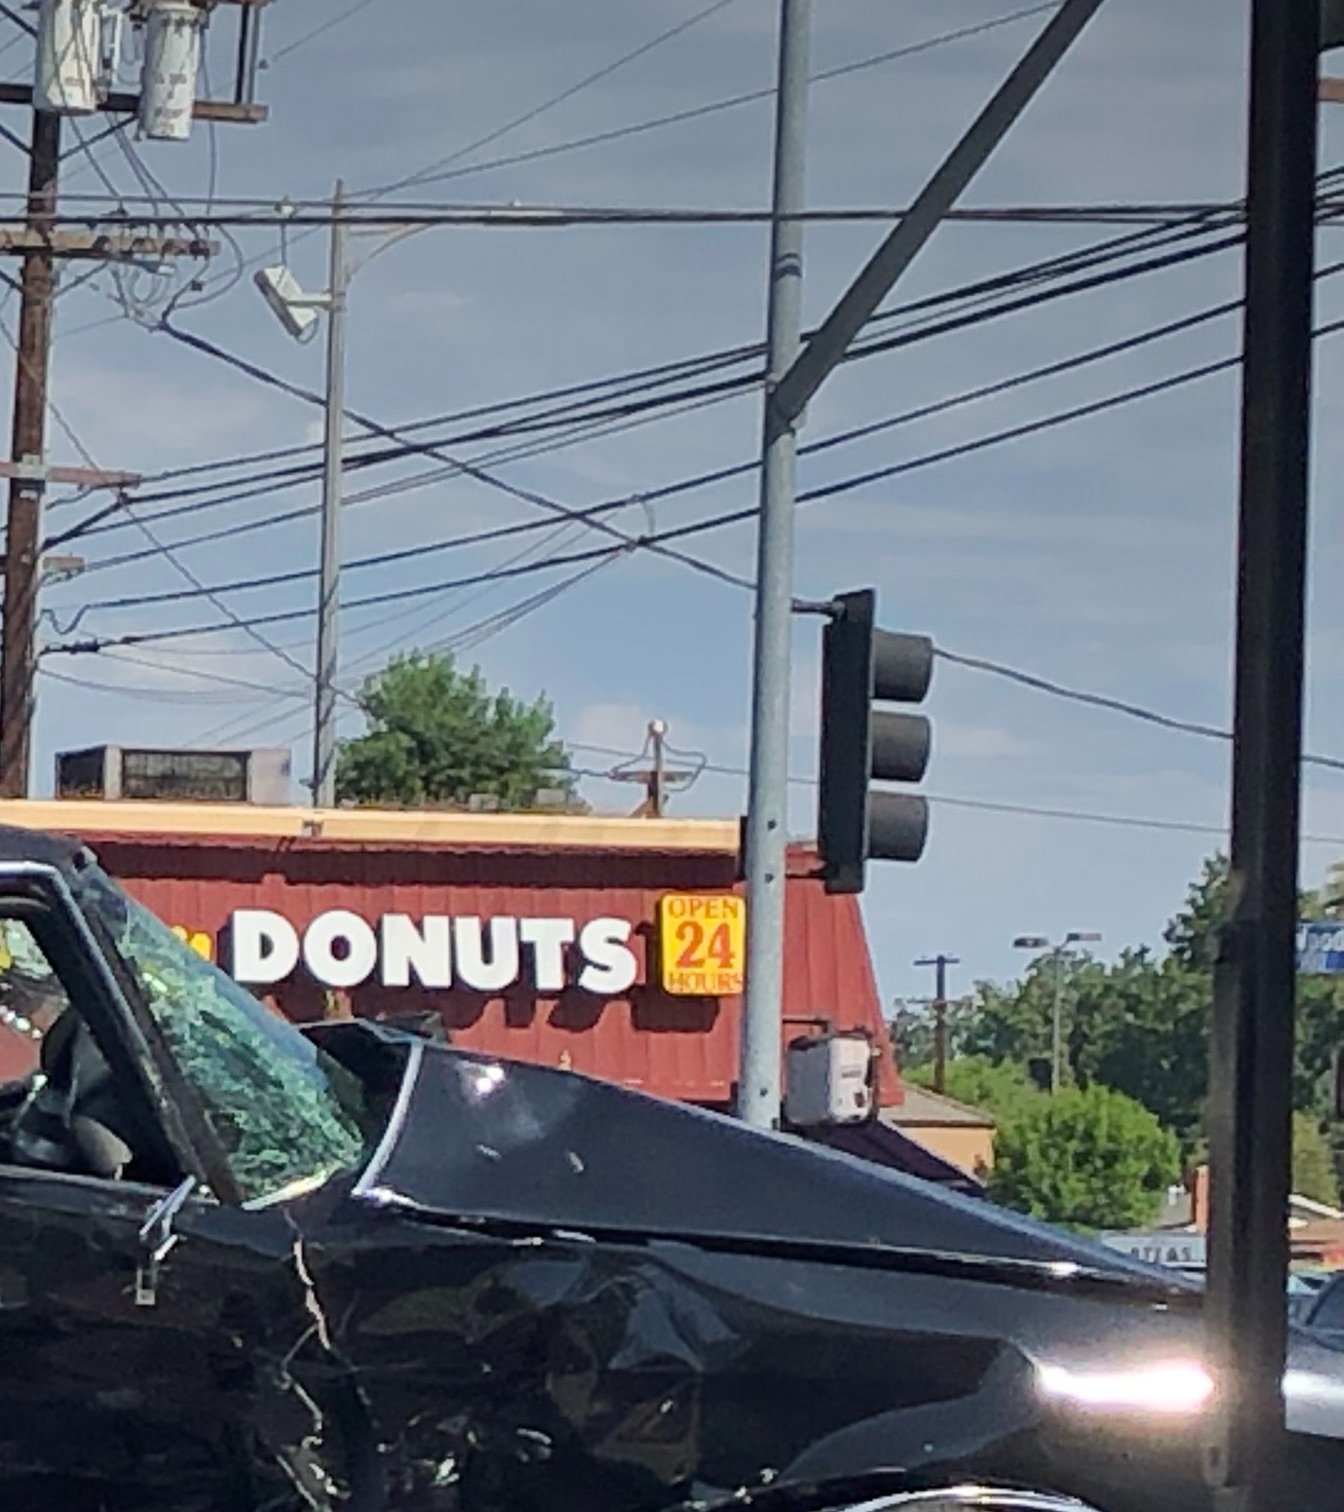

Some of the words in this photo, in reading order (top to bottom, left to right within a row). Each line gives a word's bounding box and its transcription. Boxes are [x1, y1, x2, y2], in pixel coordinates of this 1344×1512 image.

[668, 898, 739, 919] OPEN
[232, 908, 638, 994] DONUTS
[675, 920, 736, 969] 24
[668, 972, 742, 992] HOURS
